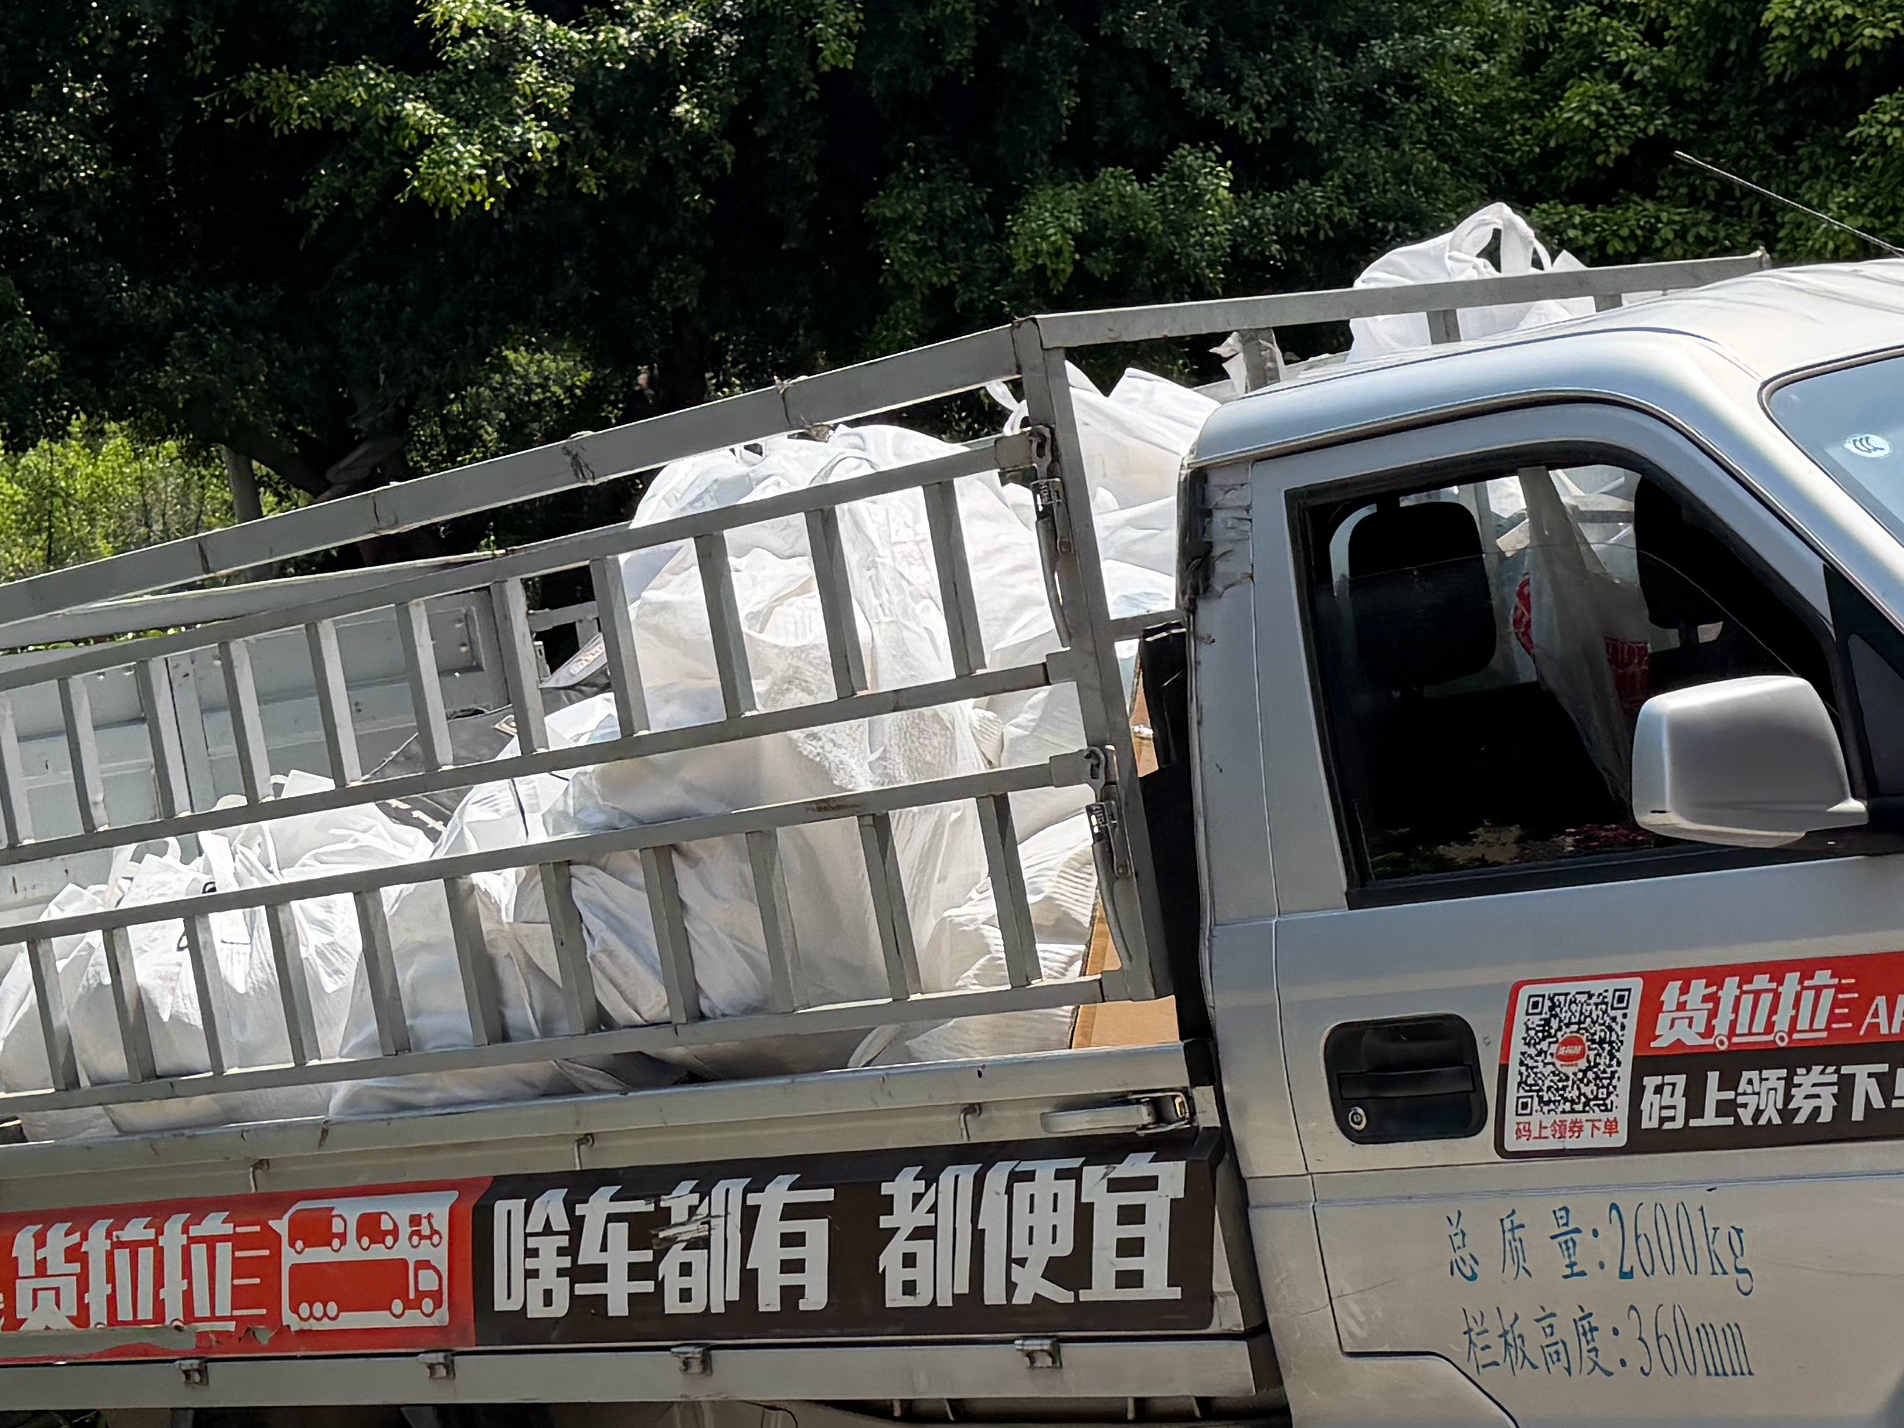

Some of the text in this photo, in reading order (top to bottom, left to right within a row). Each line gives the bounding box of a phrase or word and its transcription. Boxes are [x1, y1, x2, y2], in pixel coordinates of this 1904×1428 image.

[1649, 969, 1840, 1051] 货拉拉
[1514, 1116, 1620, 1141] 码上领券下单
[10, 1211, 238, 1333] 货拉拉
[492, 1152, 1187, 1318] 啥车都有 都便宜
[1461, 1303, 1755, 1378] 栏板高度:360mm
